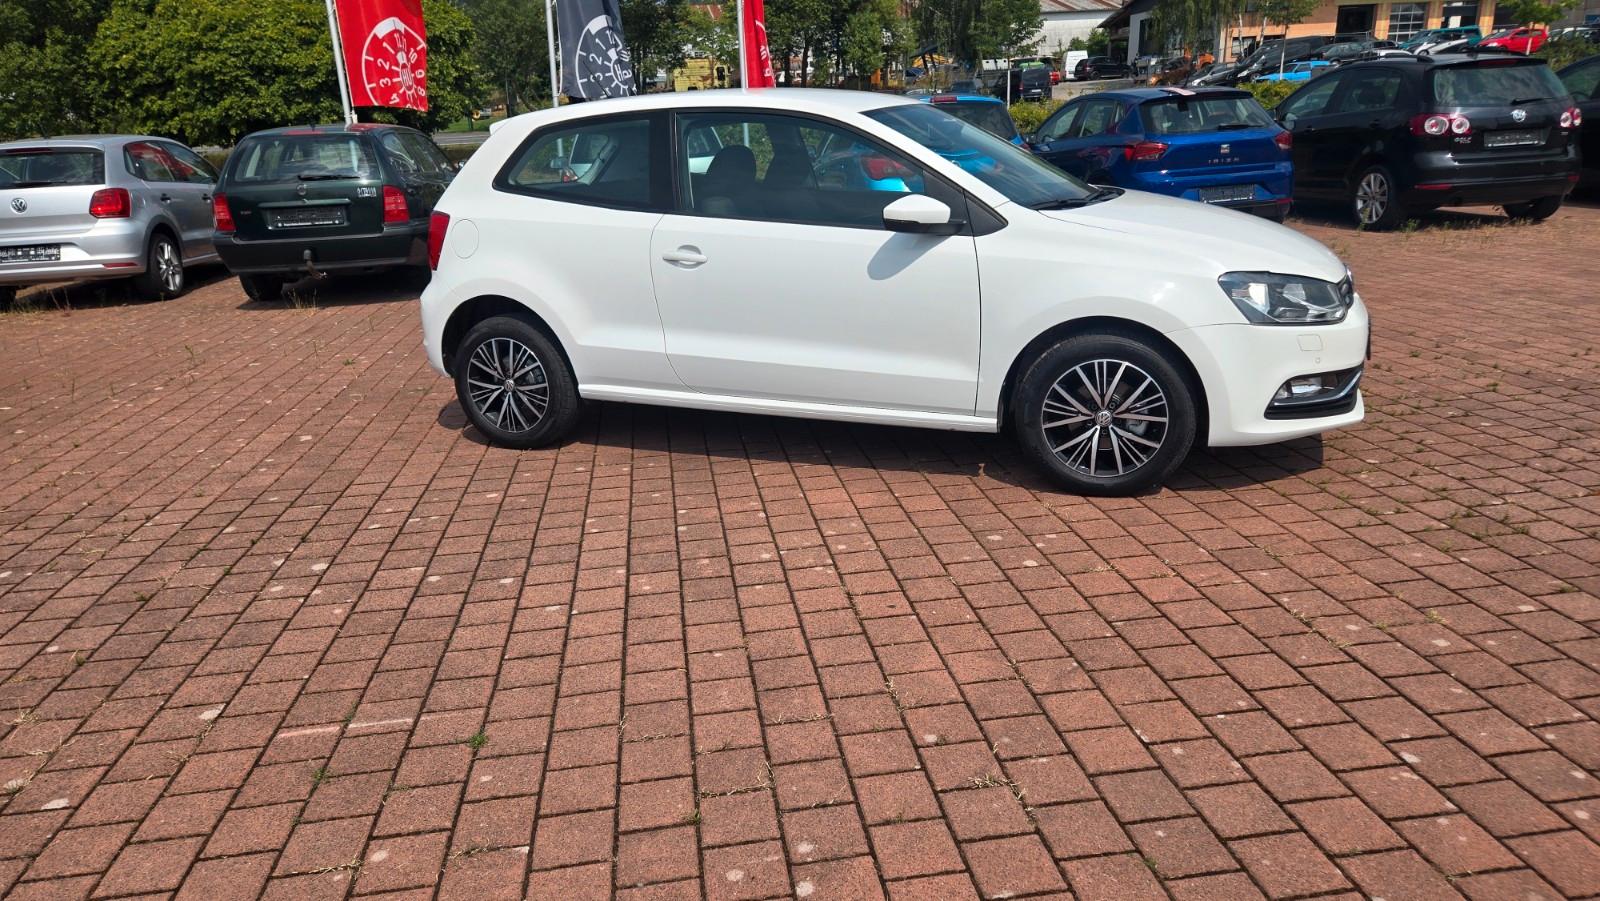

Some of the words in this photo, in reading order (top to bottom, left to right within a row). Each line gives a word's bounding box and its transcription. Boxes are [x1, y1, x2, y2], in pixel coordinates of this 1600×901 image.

[383, 42, 396, 54] 1
[595, 38, 606, 51] 1
[408, 48, 418, 64] 10
[589, 53, 603, 65] 2
[377, 58, 390, 71] 2
[379, 77, 391, 88] 3
[590, 72, 603, 83] 3
[417, 86, 426, 97] 8
[389, 93, 400, 105] 4
